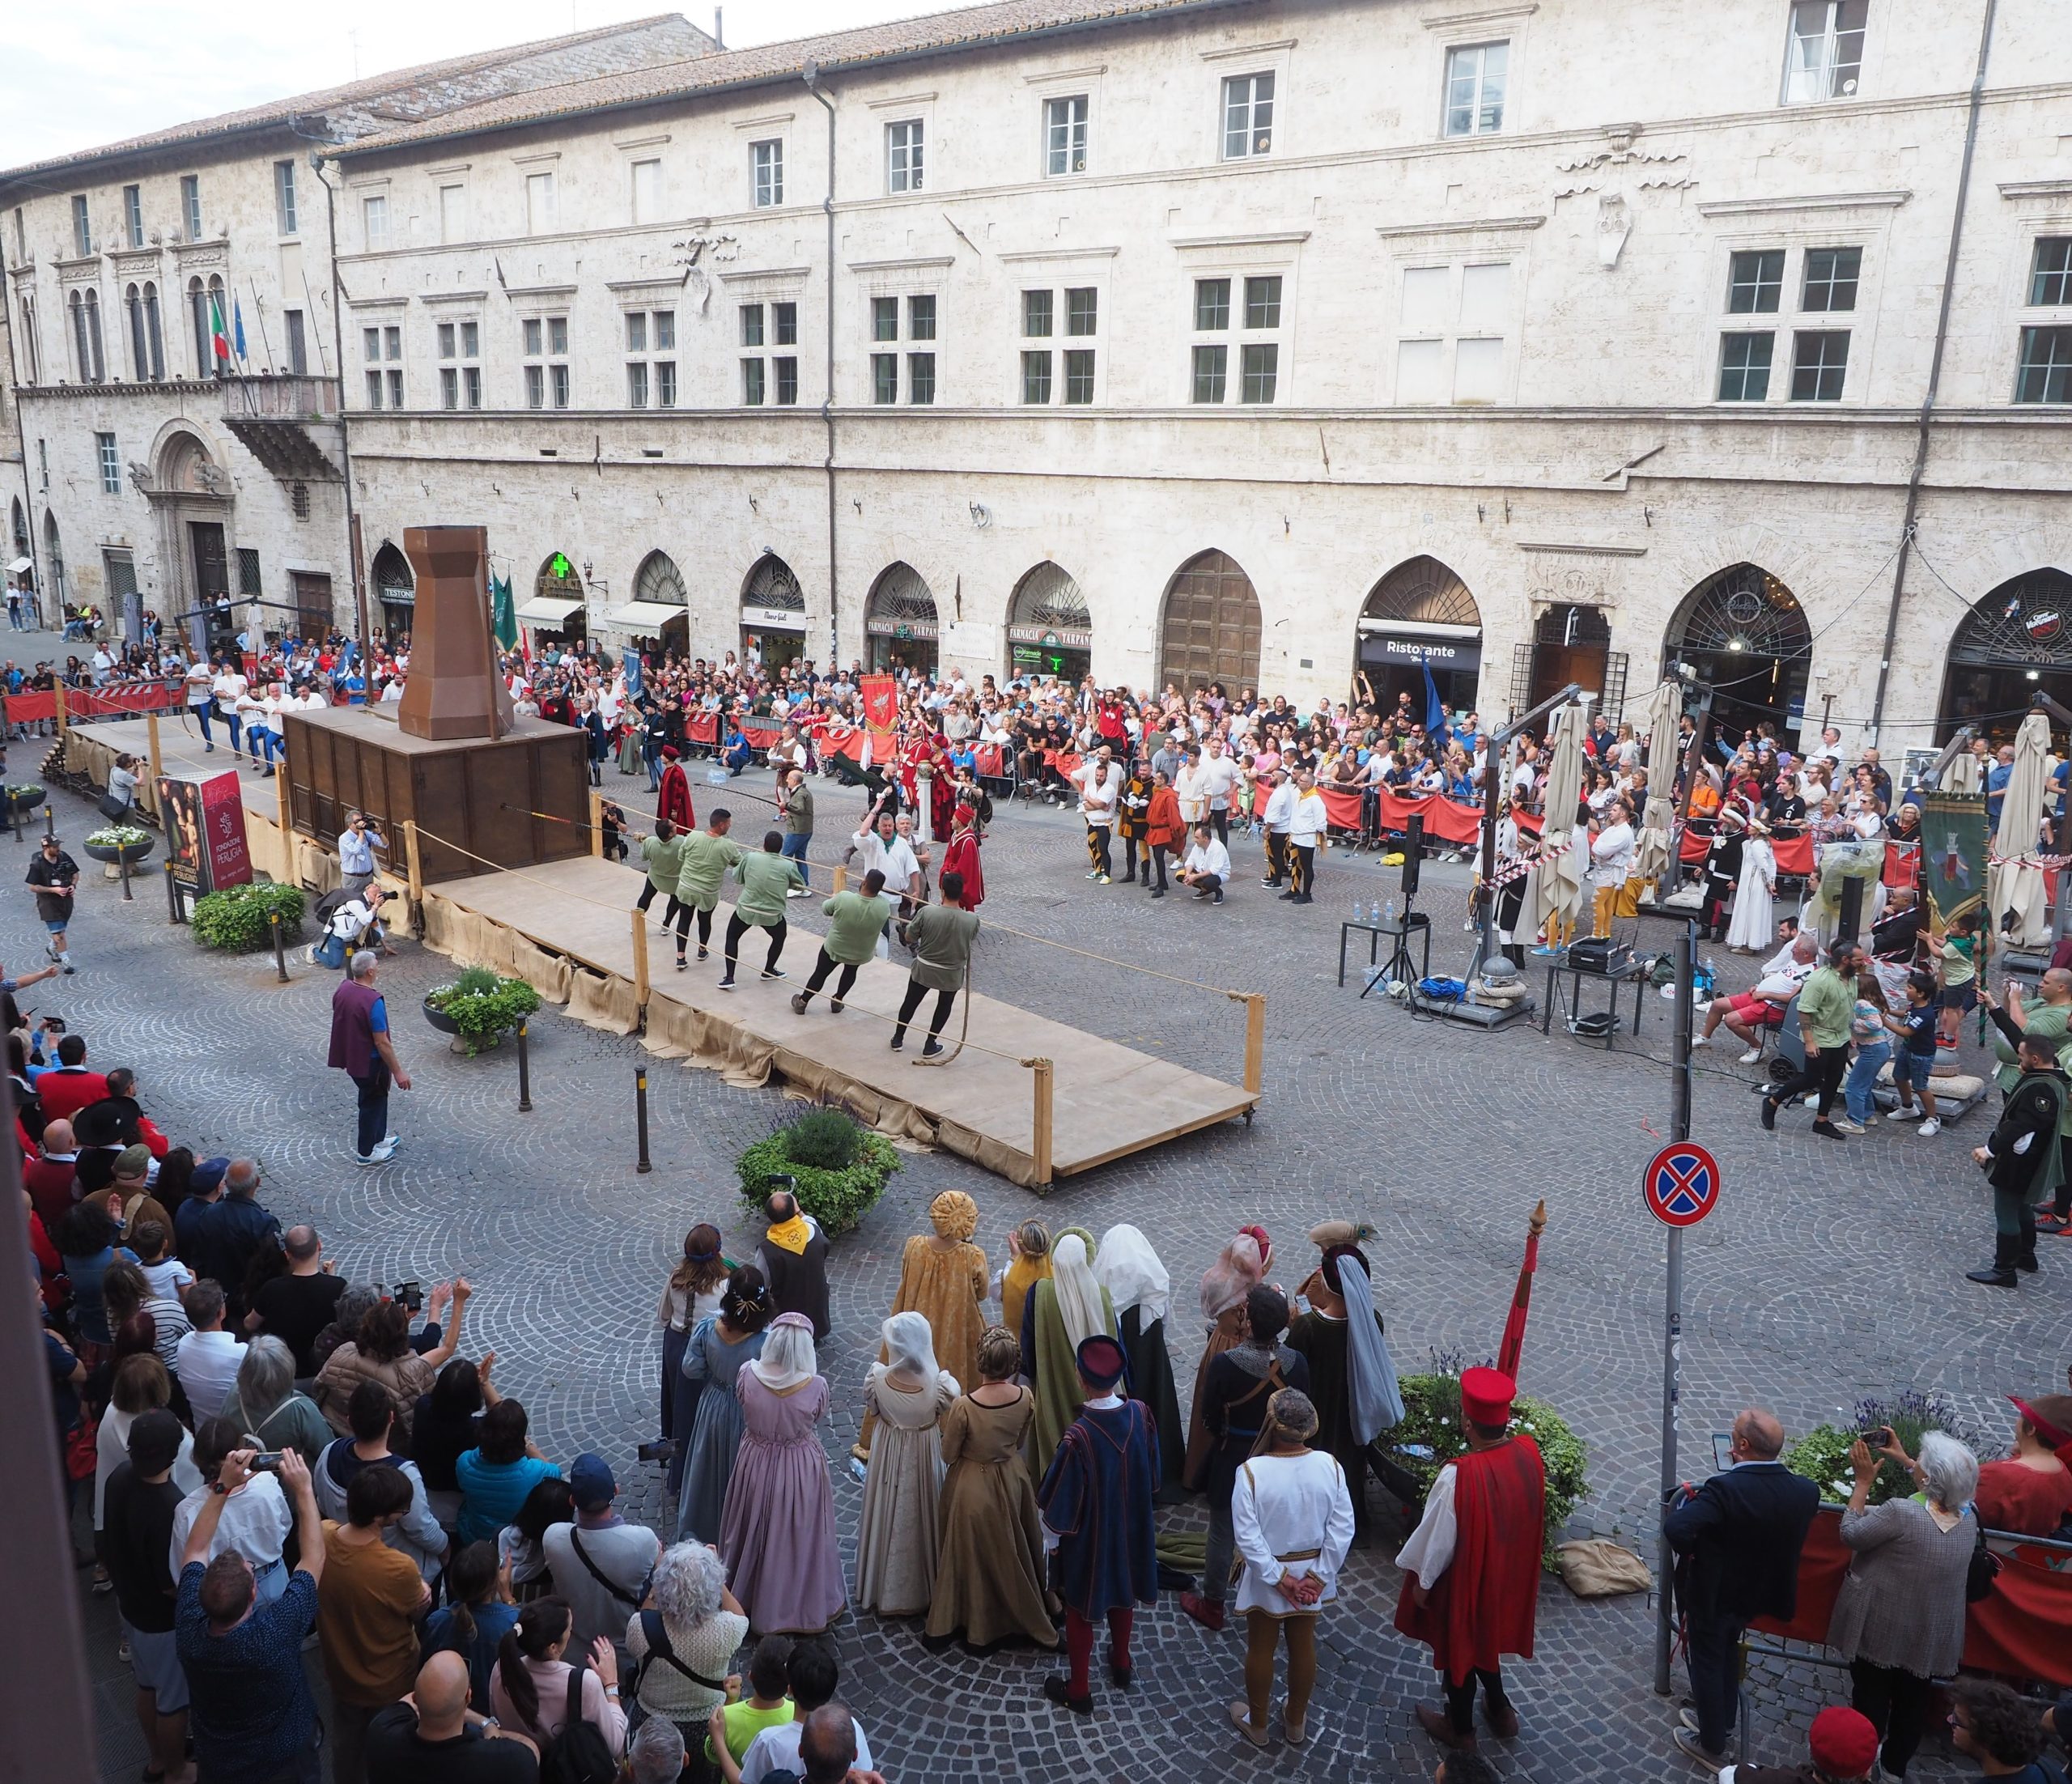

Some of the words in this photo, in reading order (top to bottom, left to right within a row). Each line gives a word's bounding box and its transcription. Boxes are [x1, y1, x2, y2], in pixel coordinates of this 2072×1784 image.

[868, 621, 894, 634] FARMACIA
[1009, 628, 1039, 641] FARMACIA
[216, 836, 241, 852] FONDAZIONE
[217, 845, 244, 864] PERUGIA
[173, 869, 198, 884] PERUGINO
